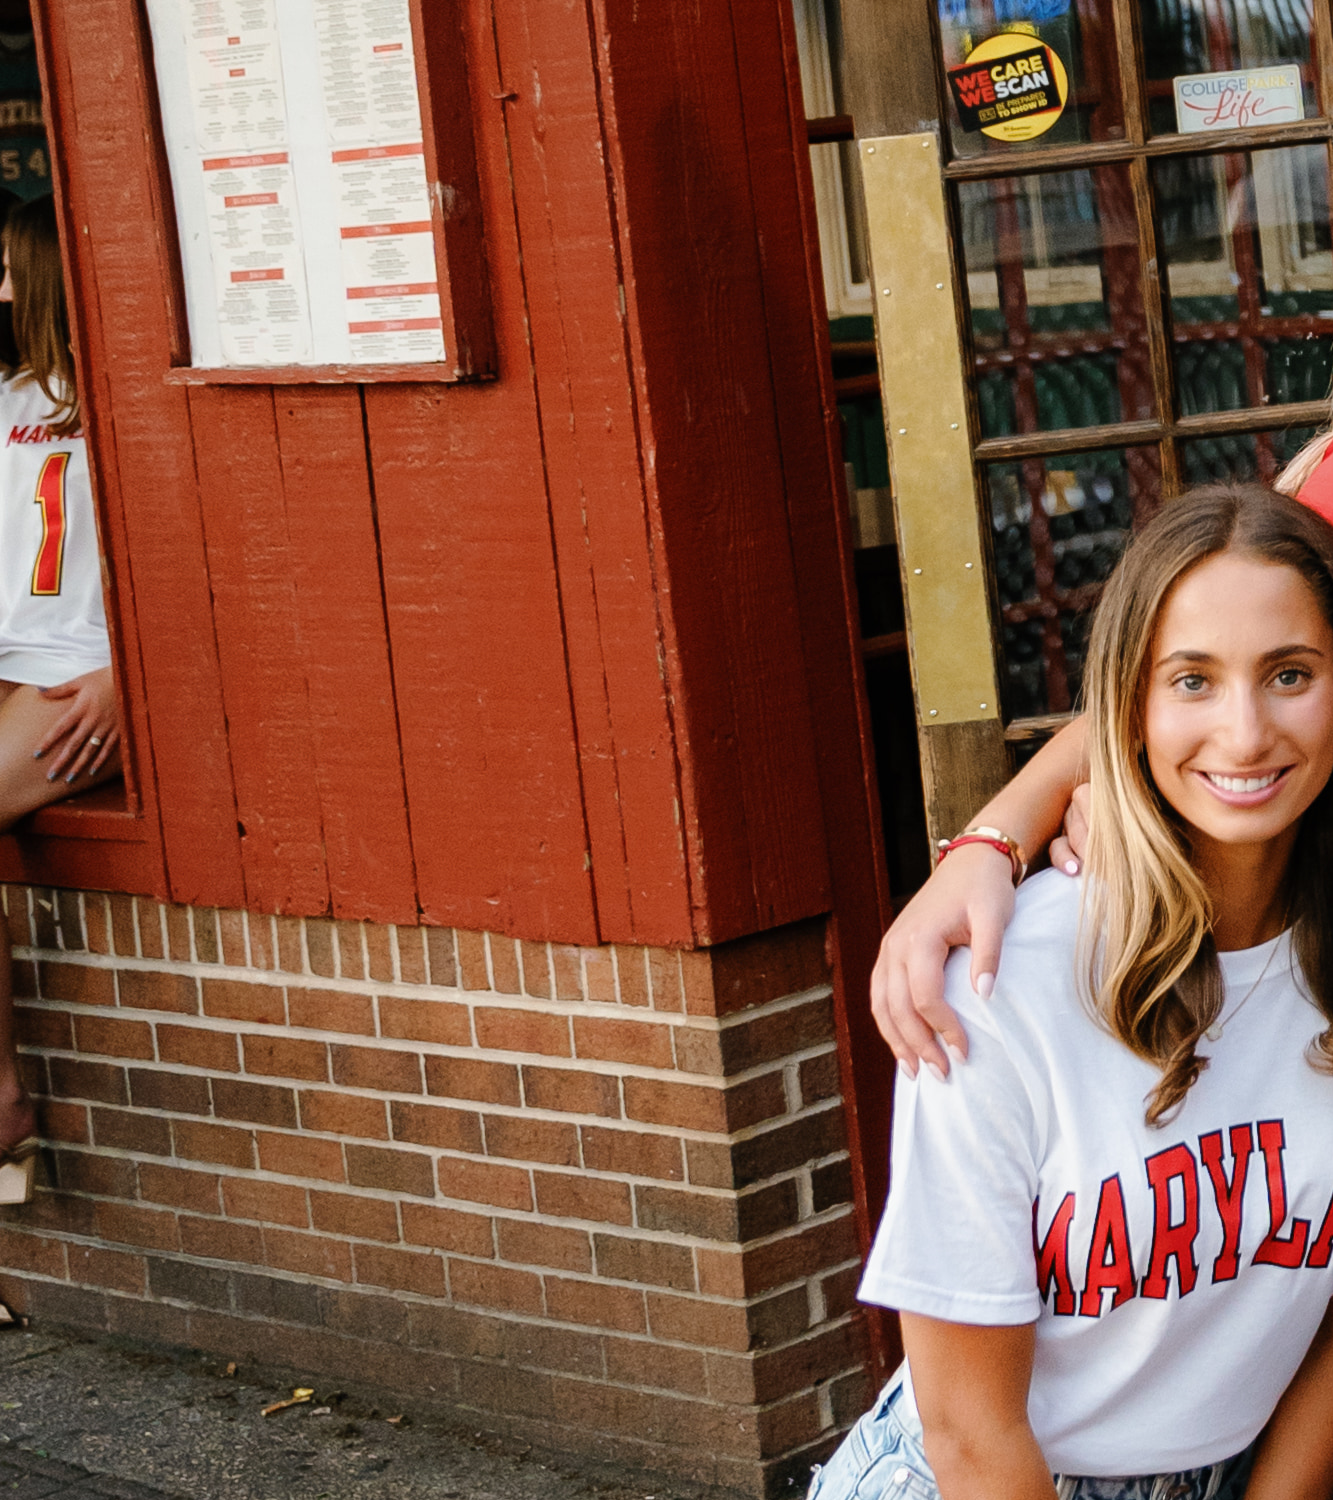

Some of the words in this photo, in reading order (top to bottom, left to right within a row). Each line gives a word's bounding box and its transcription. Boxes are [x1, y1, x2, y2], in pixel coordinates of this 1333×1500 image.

[955, 69, 992, 92] WE
[990, 54, 1045, 82] CARE
[959, 86, 997, 108] WE
[994, 70, 1050, 99] SCAN
[31, 452, 72, 596] 1
